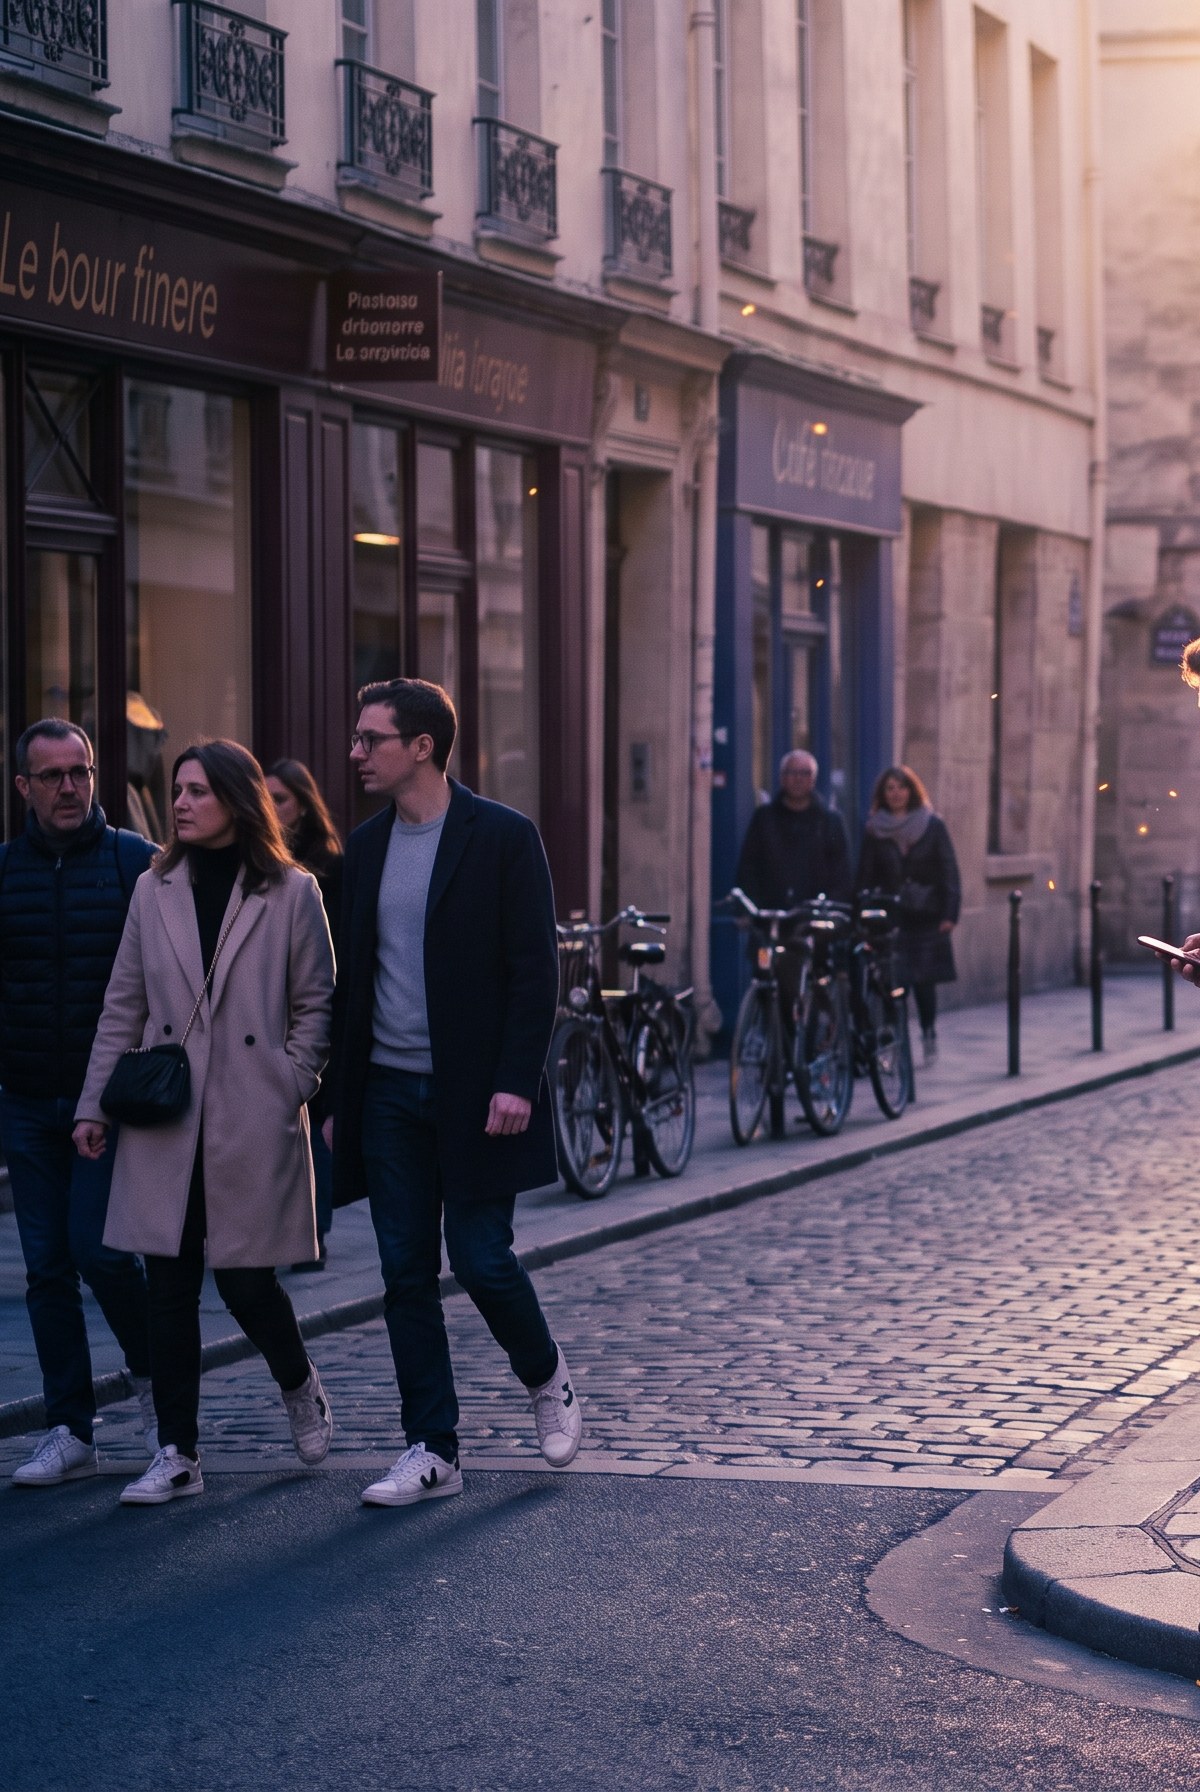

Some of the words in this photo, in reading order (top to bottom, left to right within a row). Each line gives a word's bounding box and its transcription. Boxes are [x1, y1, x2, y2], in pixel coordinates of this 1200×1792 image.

[0, 210, 39, 300] Le
[47, 221, 127, 318] bour
[132, 244, 219, 340] finere
